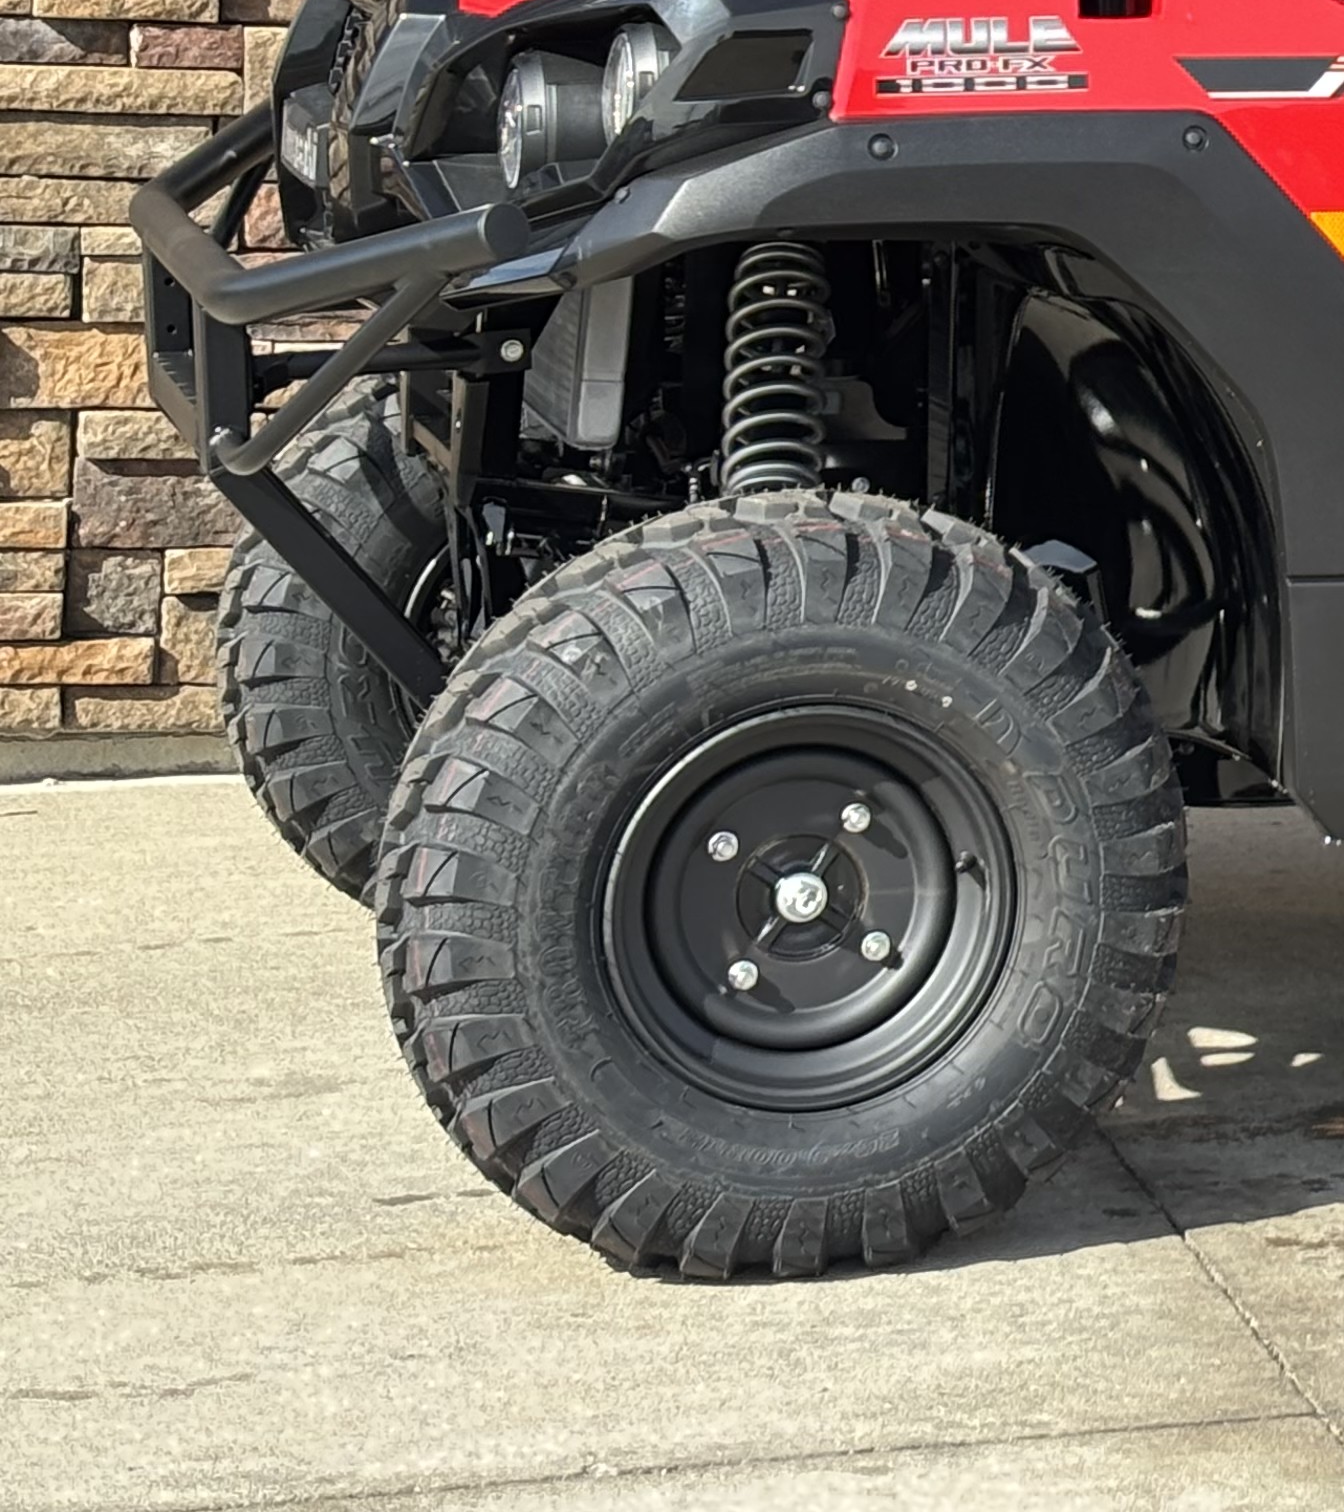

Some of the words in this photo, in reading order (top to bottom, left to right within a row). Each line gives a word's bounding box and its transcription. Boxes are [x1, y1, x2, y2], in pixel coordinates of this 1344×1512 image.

[879, 16, 1084, 58] MULE
[895, 74, 1070, 94] 1000
[1016, 770, 1093, 1044] DURO
